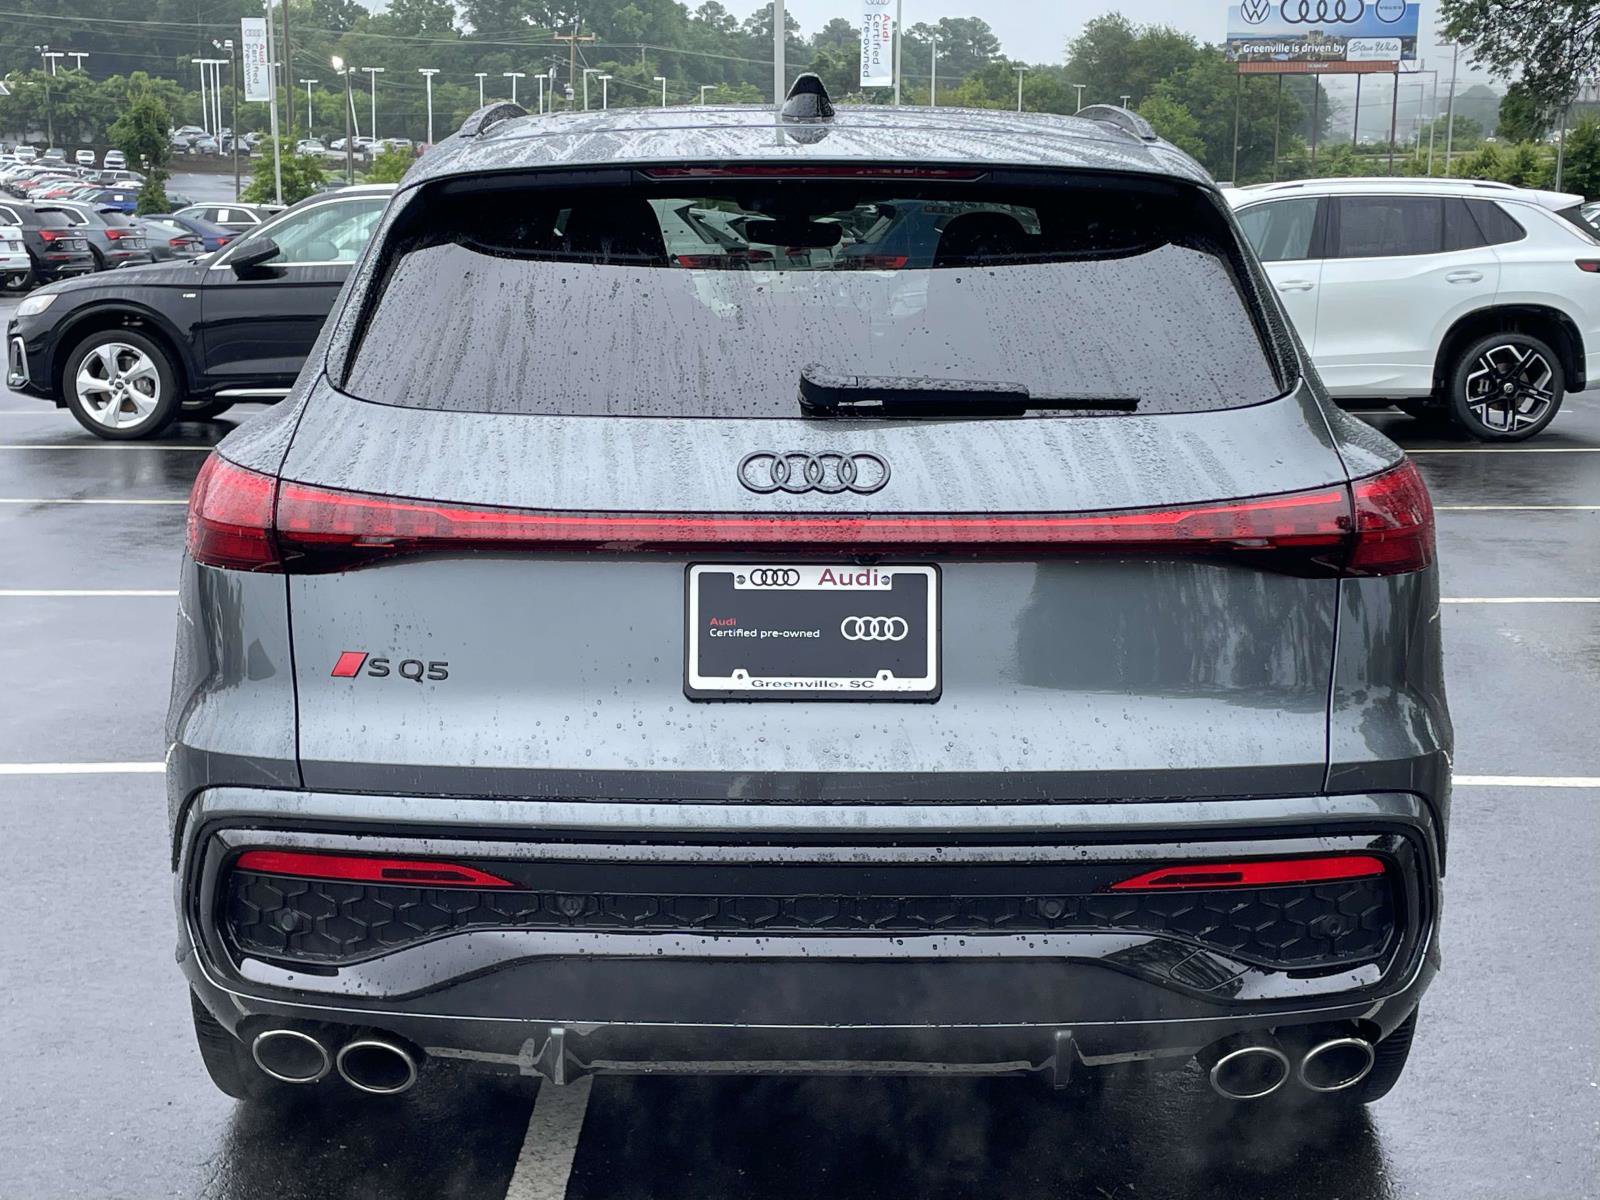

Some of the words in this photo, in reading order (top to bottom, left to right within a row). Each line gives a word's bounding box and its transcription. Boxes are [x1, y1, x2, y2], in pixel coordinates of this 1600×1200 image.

[872, 13, 881, 65] Certified
[882, 13, 891, 42] Audi
[258, 43, 266, 66] Audi
[863, 13, 872, 78] Pre-owned
[1243, 43, 1290, 53] Greenville
[1292, 43, 1300, 53] is
[1301, 43, 1331, 53] driven
[1333, 43, 1346, 55] by
[244, 43, 253, 95] Pre-owned
[251, 43, 260, 85] Certified
[818, 568, 878, 586] Audi
[710, 617, 737, 626] Audi
[709, 628, 758, 637] Certified
[760, 629, 821, 639] pre-owned
[849, 680, 875, 688] SC
